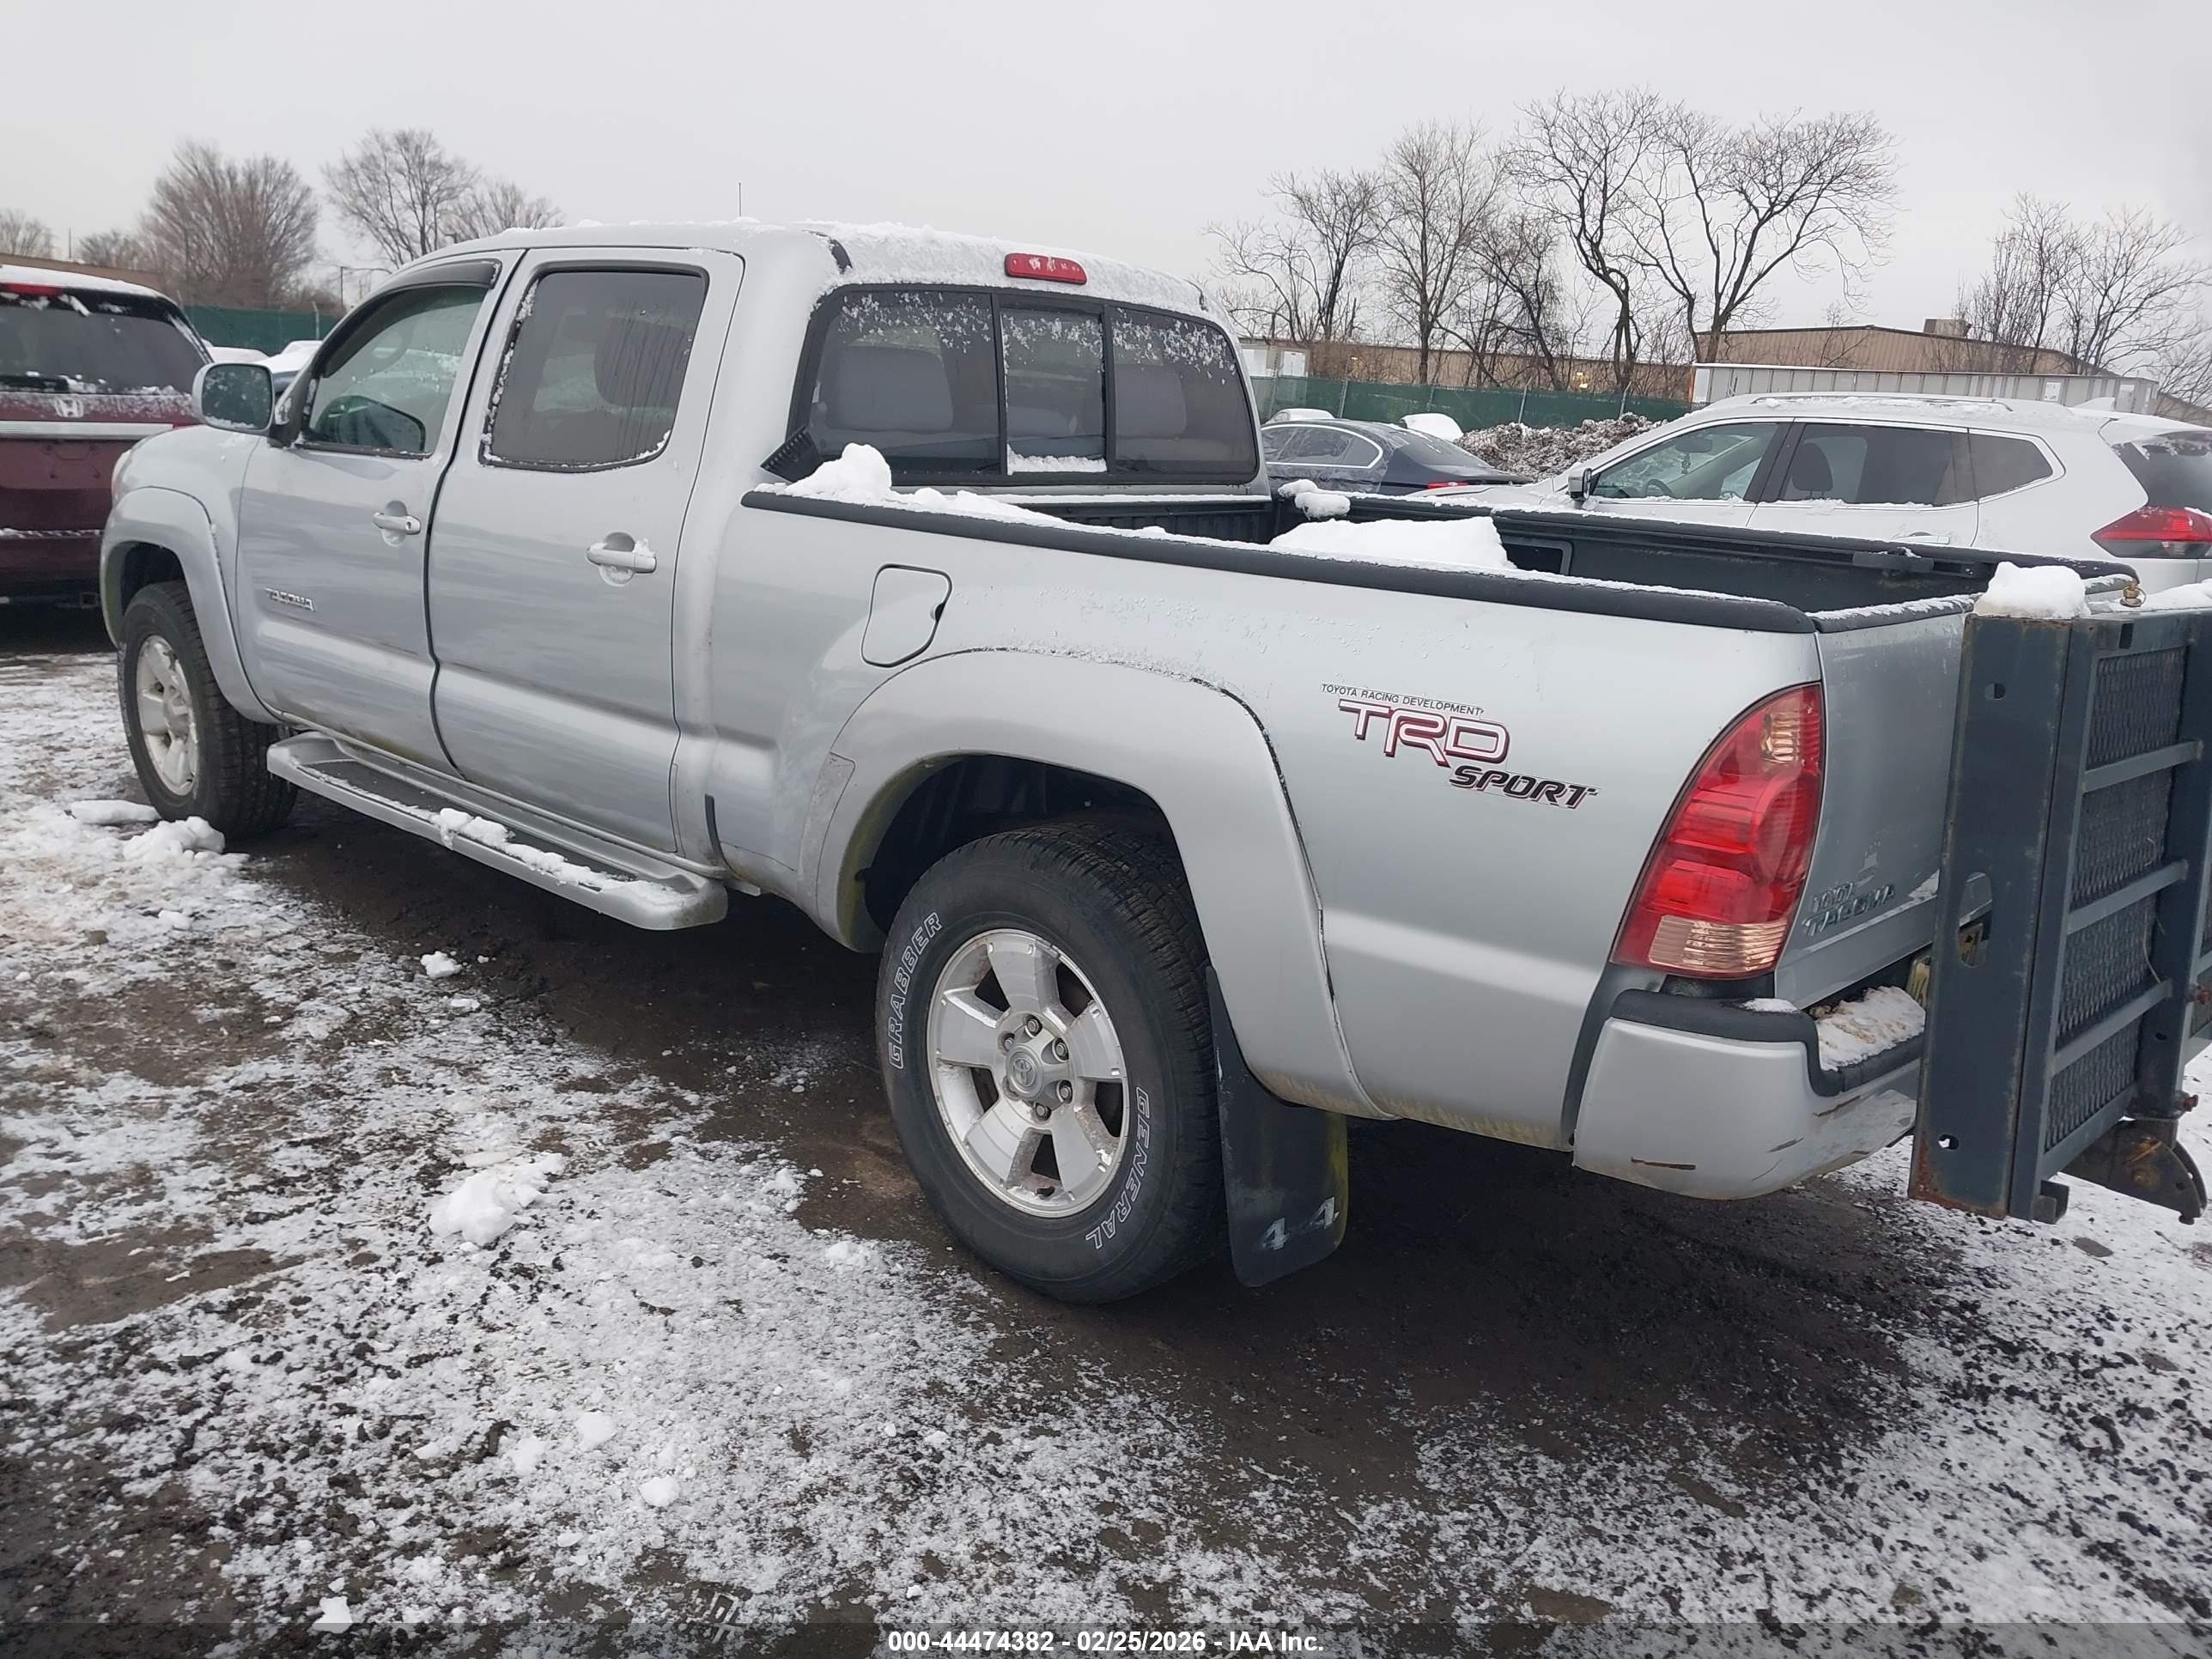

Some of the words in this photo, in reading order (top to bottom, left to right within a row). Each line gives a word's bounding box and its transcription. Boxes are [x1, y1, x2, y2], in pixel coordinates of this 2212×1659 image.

[264, 586, 316, 612] TACOMA
[1322, 684, 1358, 697] TOYOTA
[1361, 690, 1400, 704] RACING
[1402, 696, 1485, 717] DEVELOPMENT
[1338, 698, 1510, 768] TRD
[1449, 764, 1599, 810] SPORT
[888, 912, 943, 1070] GRABBER
[1085, 1086, 1151, 1250] GENERAL
